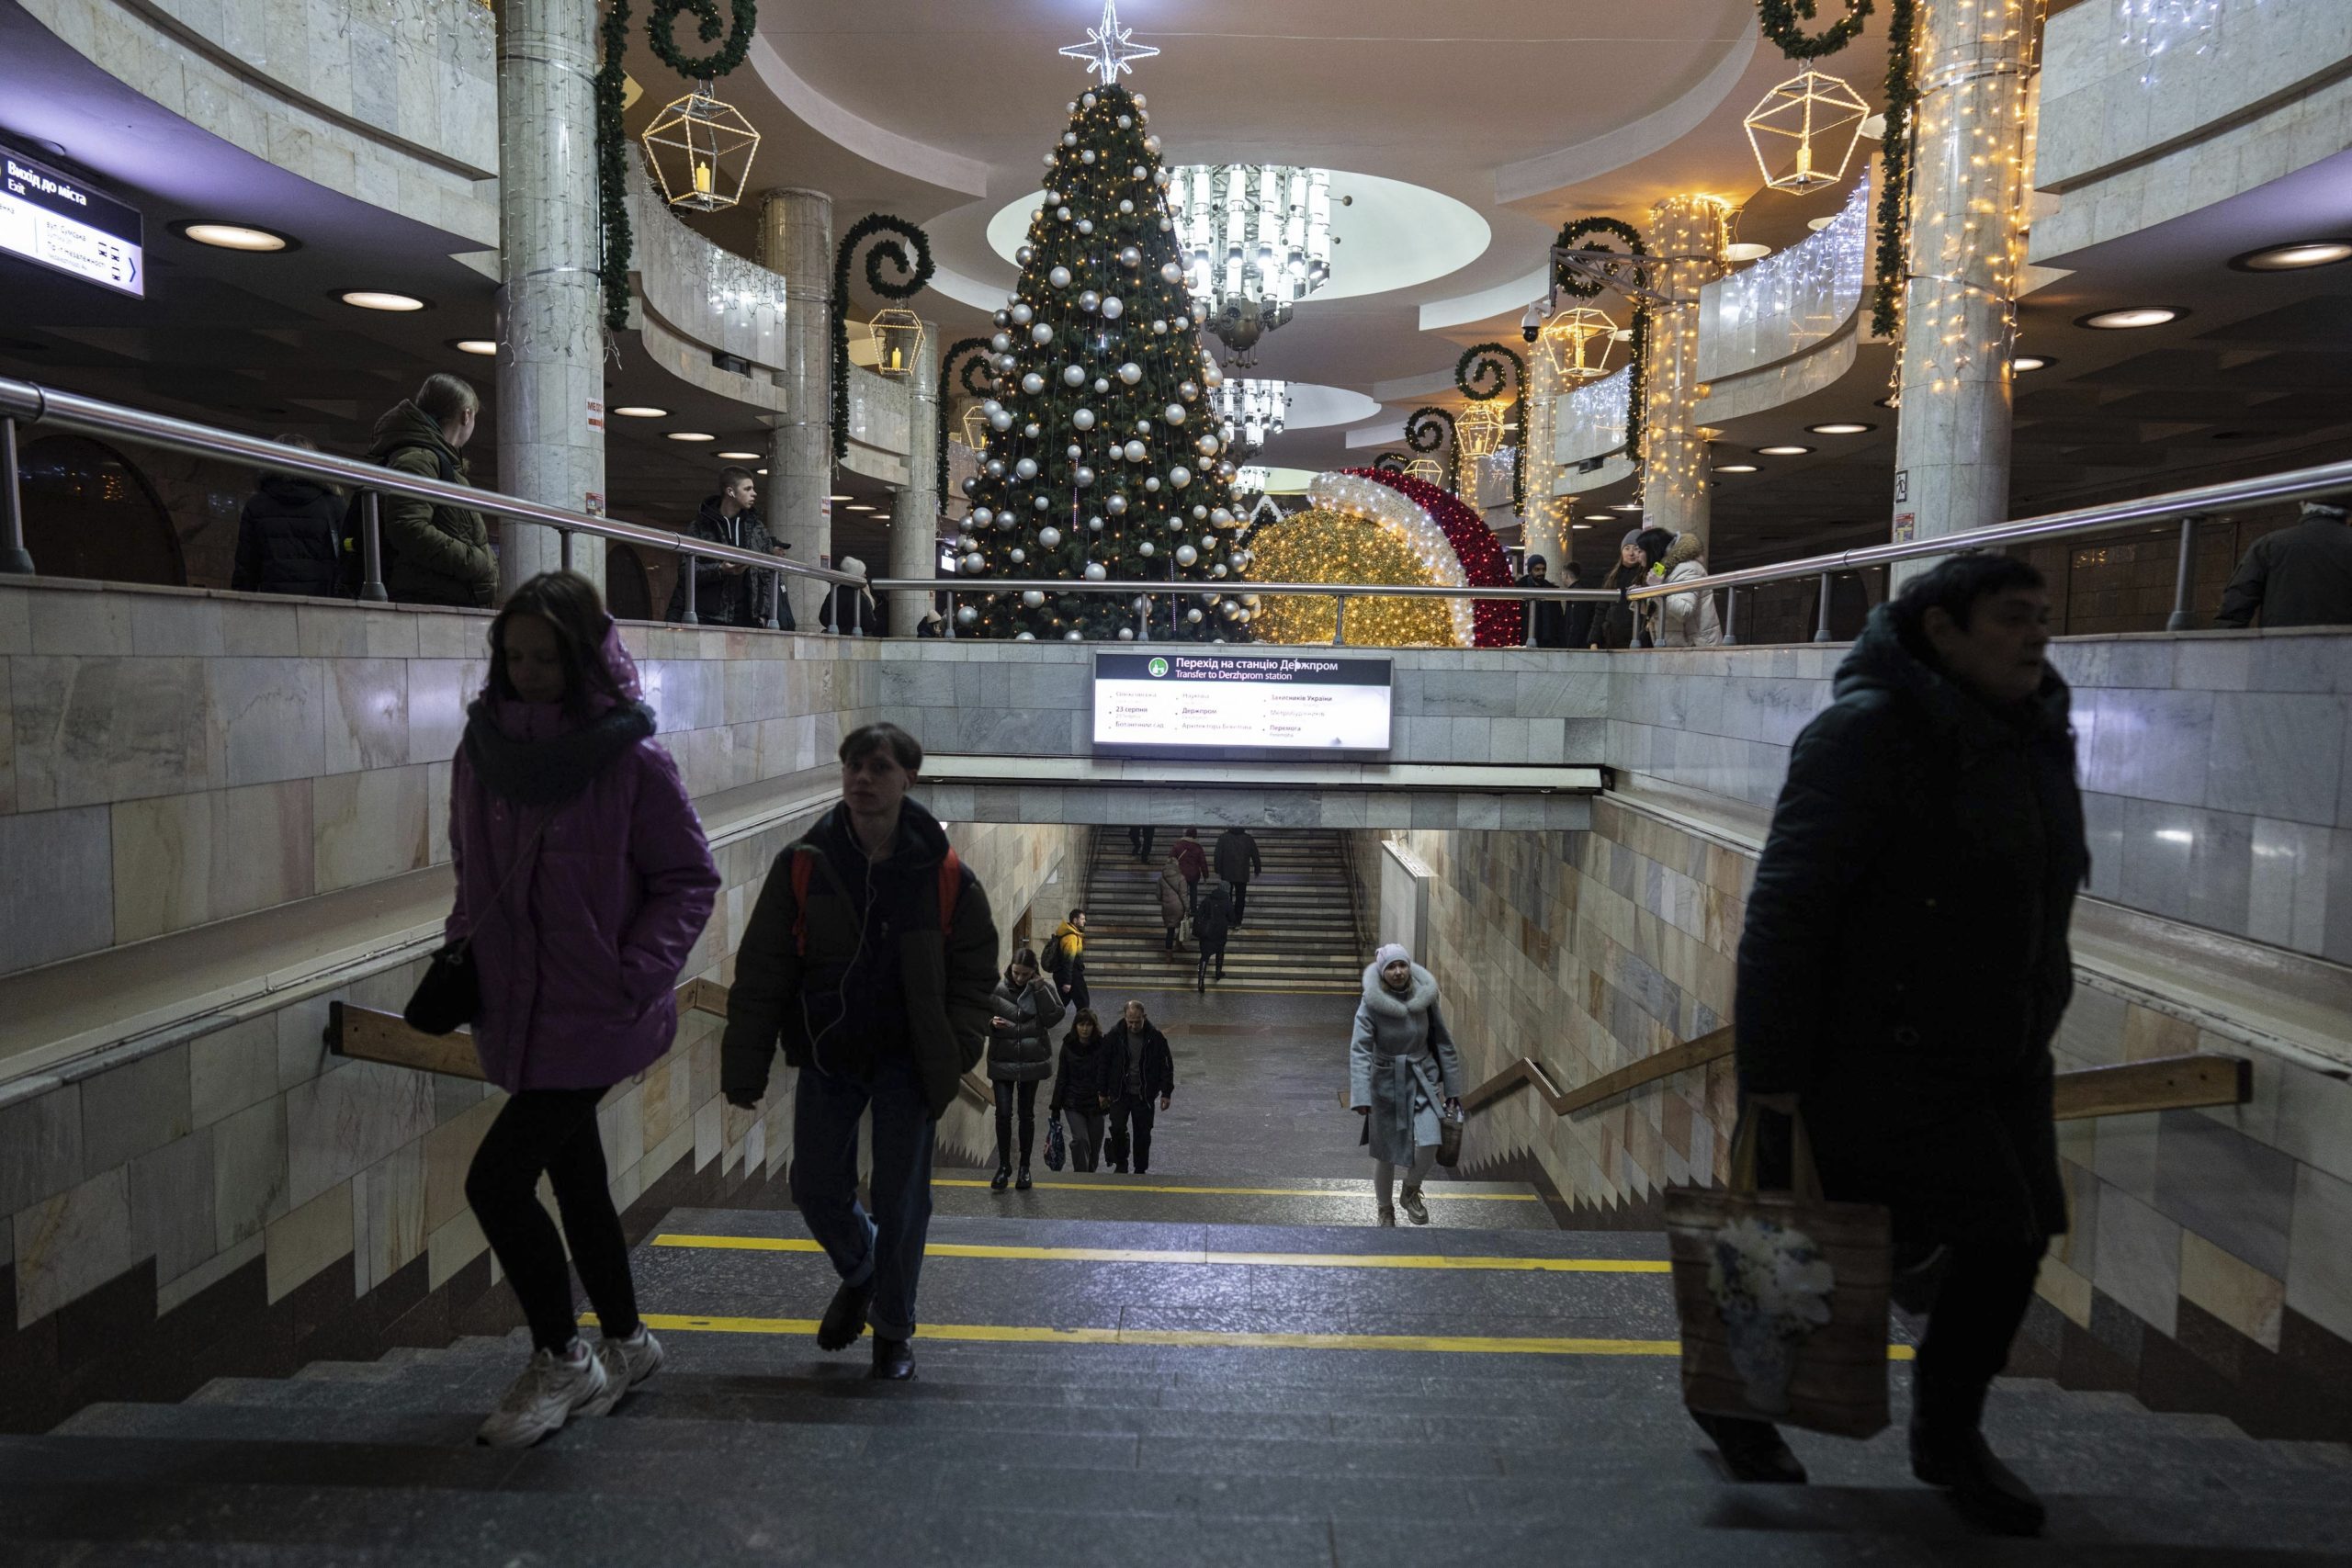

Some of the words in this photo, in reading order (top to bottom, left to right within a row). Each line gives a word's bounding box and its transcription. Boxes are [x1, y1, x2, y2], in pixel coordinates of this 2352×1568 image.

[7, 161, 40, 188] Вихід
[41, 178, 57, 194] до
[58, 186, 87, 206] міста
[8, 178, 26, 195] Exit
[1176, 657, 1219, 671] Перехід
[1221, 660, 1234, 669] на
[1236, 659, 1279, 671] станцію
[1280, 658, 1339, 672] Держпром
[1175, 669, 1206, 679] Transfer
[1208, 671, 1217, 679] to
[1218, 671, 1263, 682] Derzhprom
[1265, 671, 1293, 681] station
[1182, 707, 1217, 716] Держпром
